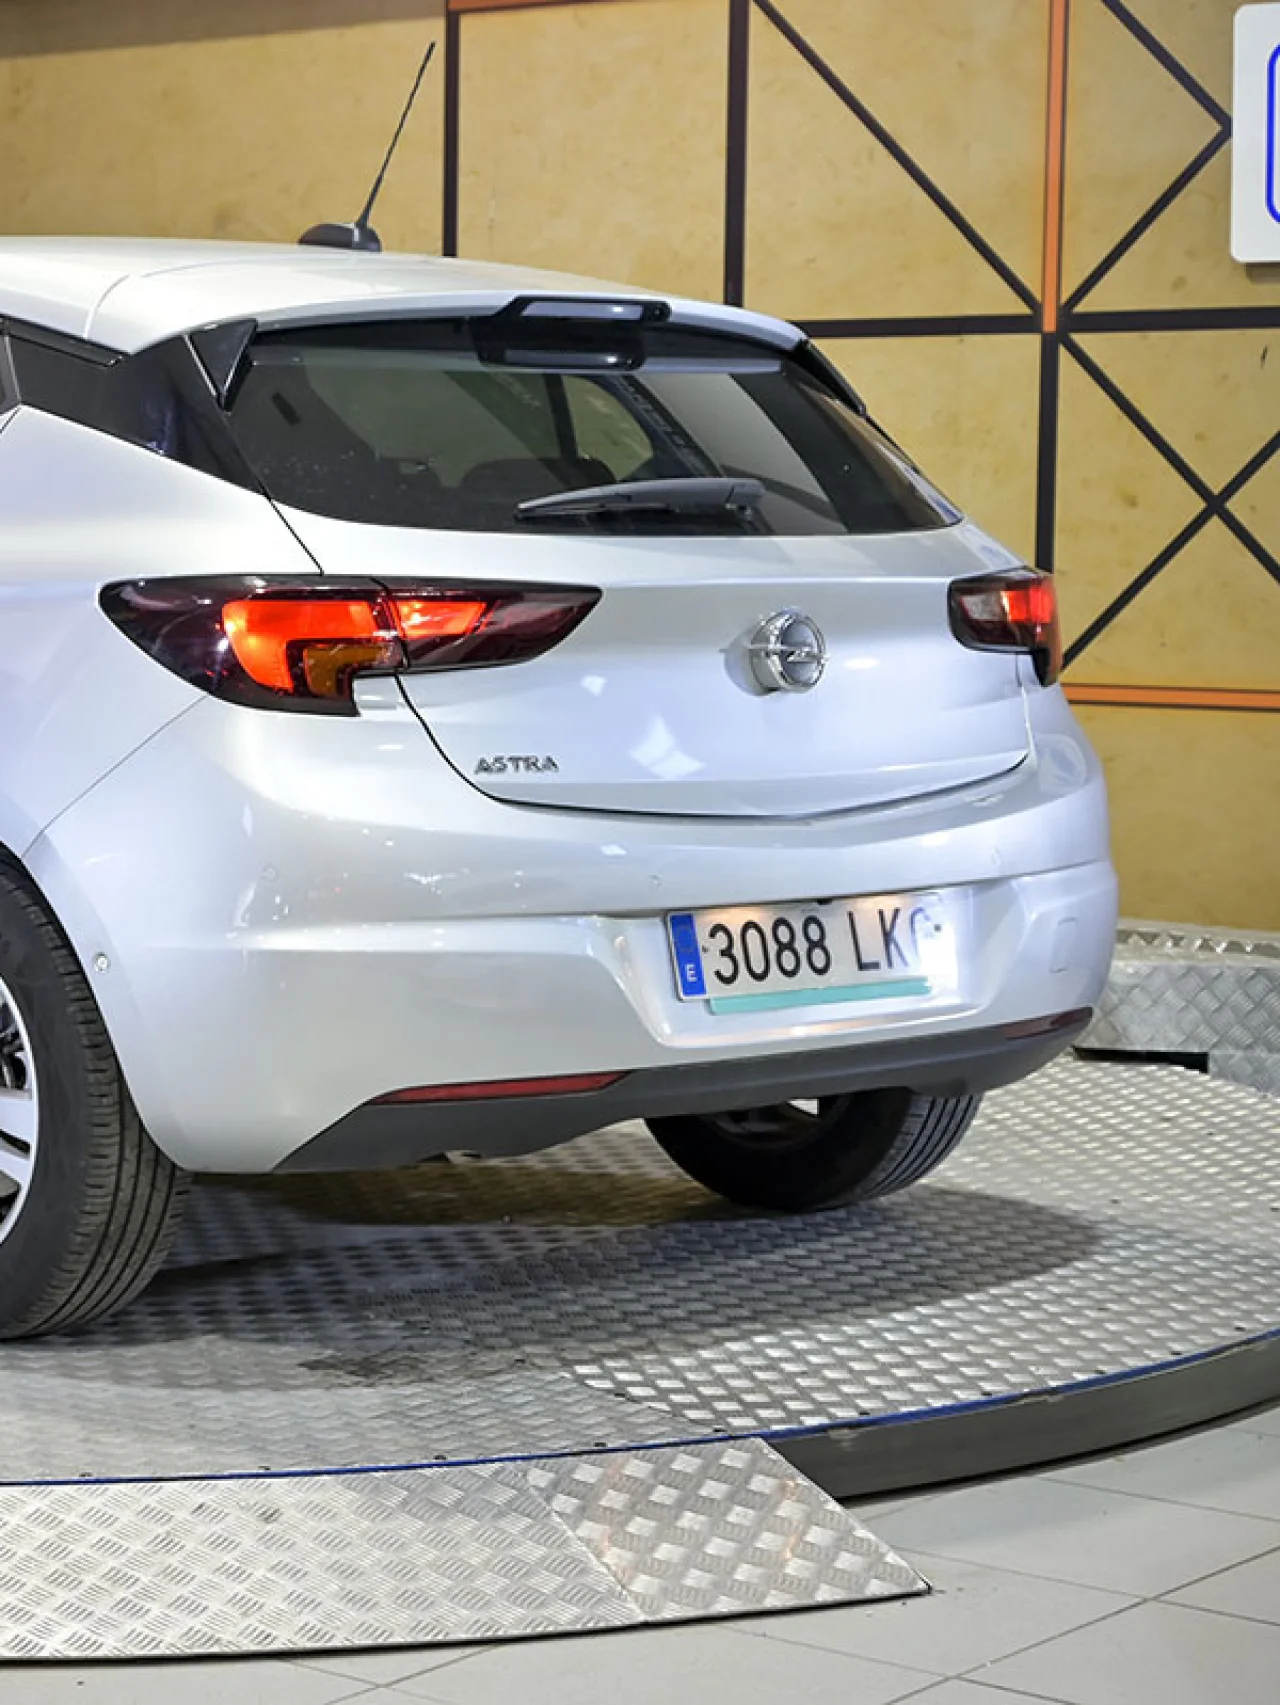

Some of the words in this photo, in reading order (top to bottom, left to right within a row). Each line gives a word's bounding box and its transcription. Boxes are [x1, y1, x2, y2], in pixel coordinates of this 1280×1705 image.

[474, 755, 560, 775] ASTRA
[708, 915, 832, 985] 3088
[684, 963, 698, 983] E
